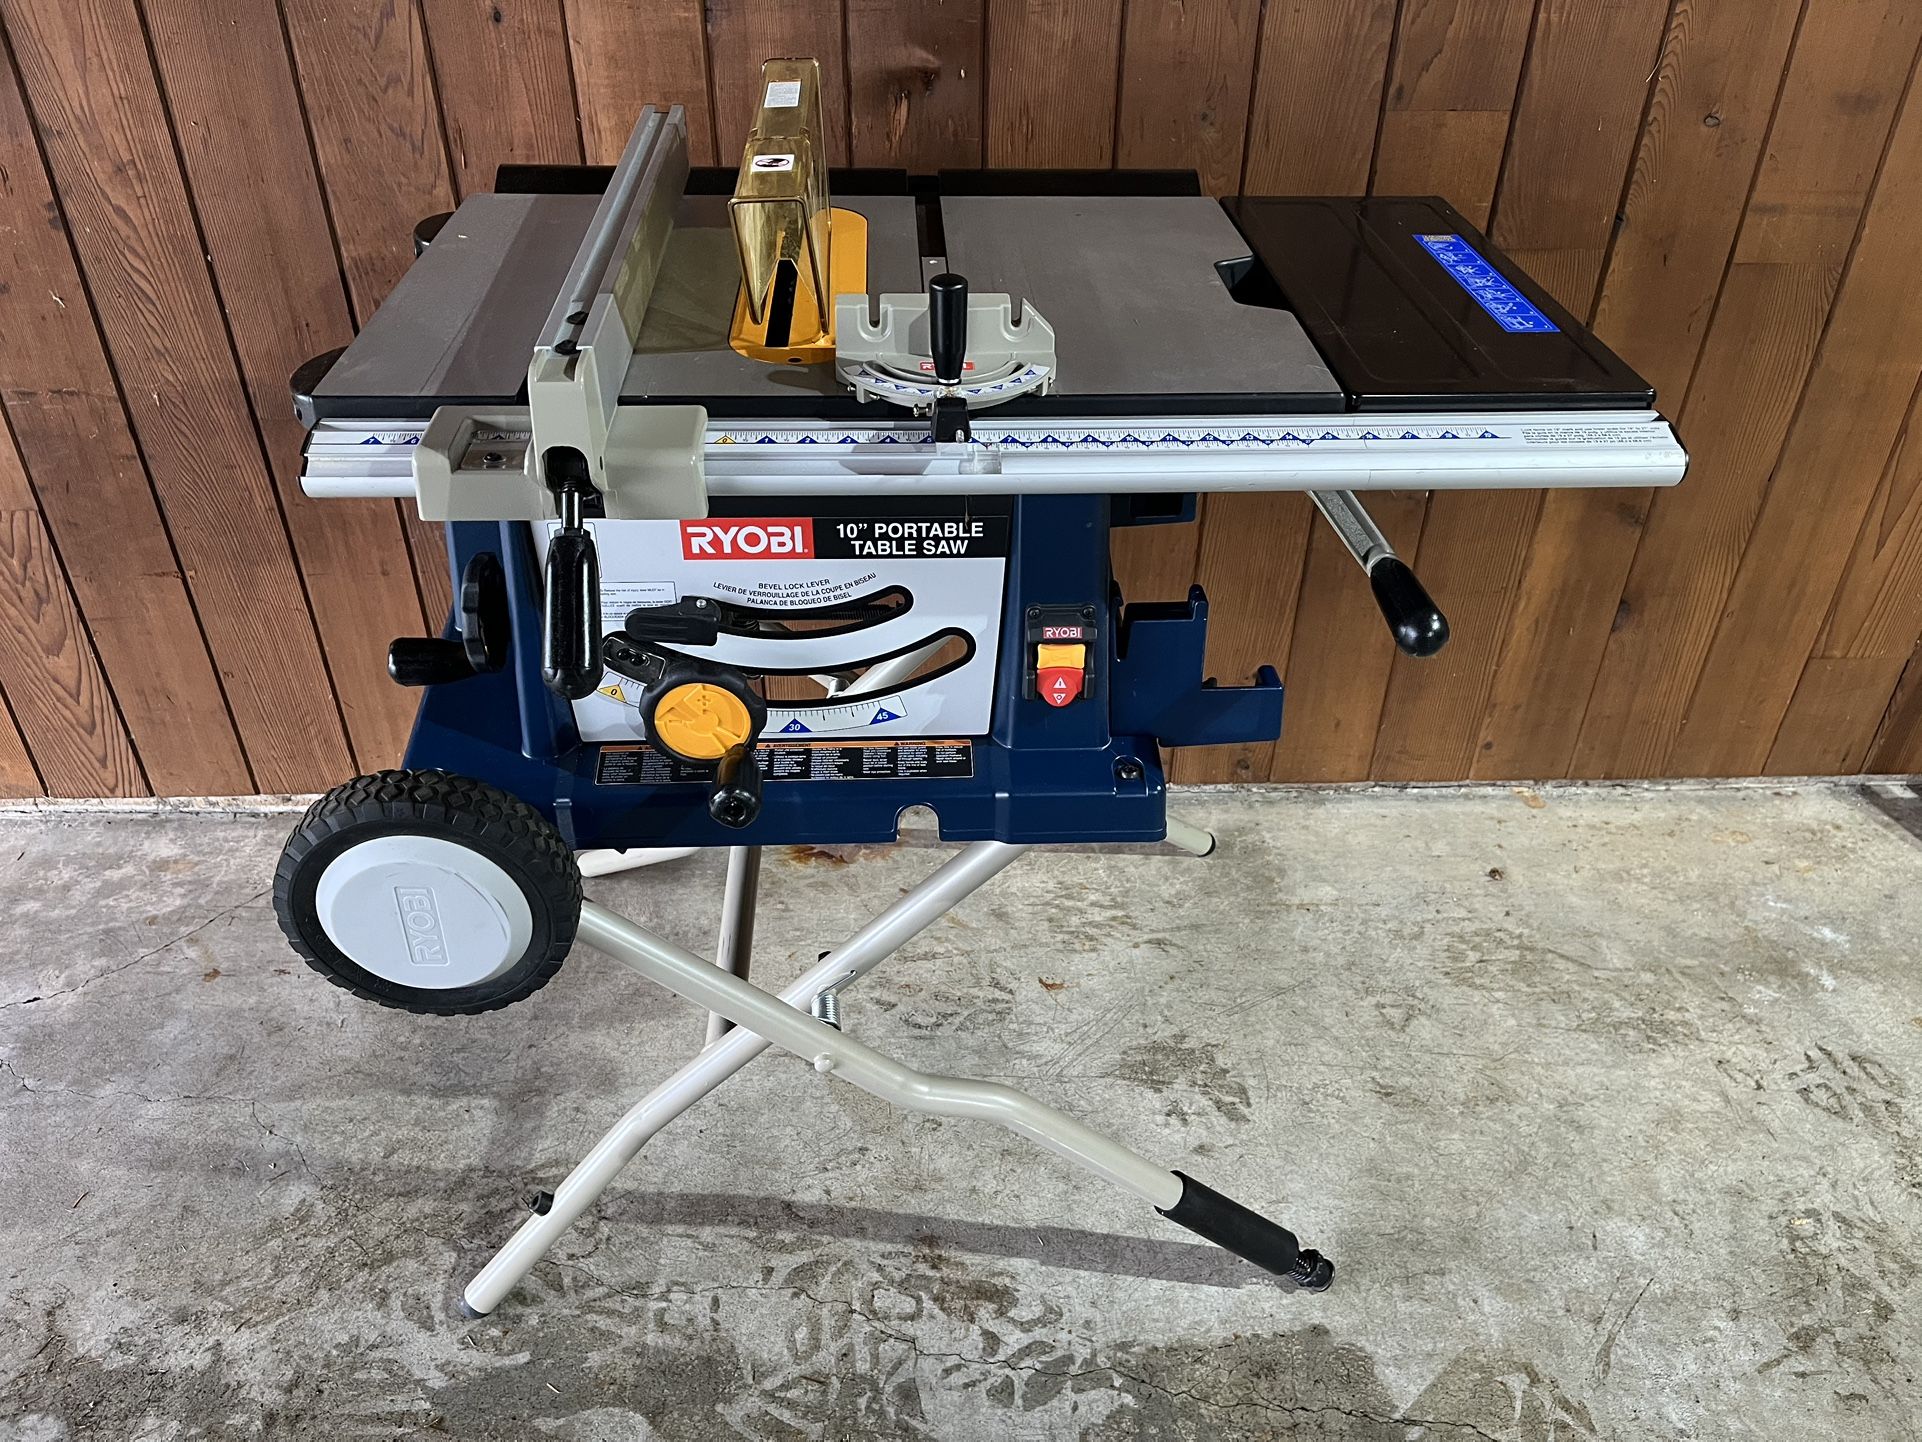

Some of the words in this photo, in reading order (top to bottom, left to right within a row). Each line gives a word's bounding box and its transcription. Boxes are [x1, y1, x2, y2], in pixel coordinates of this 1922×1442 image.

[686, 525, 804, 554] RYOBI
[874, 522, 984, 538] PORTABLE
[850, 540, 917, 555] TABLE
[922, 539, 969, 555] SAW
[713, 581, 737, 594] LEVIER
[738, 587, 747, 596] DE
[748, 589, 800, 599] VERROUILLAGE
[800, 590, 810, 598] DE
[811, 588, 820, 597] LA
[820, 584, 844, 595] COUPE
[844, 581, 854, 590] EN
[854, 572, 877, 587] BISEAU
[758, 582, 783, 590] BEVEL
[784, 582, 805, 590] LOCK
[805, 578, 831, 589] LEVER
[746, 597, 779, 607] PALANCA
[779, 599, 789, 607] DE
[789, 597, 822, 606] BLOQUEO
[823, 595, 832, 603] DE
[833, 592, 853, 602] BISEL
[1045, 627, 1080, 638] RYOBI
[610, 688, 618, 696] 0
[876, 711, 889, 721] 45
[788, 723, 801, 731] 30
[400, 888, 442, 962] RYOBI
